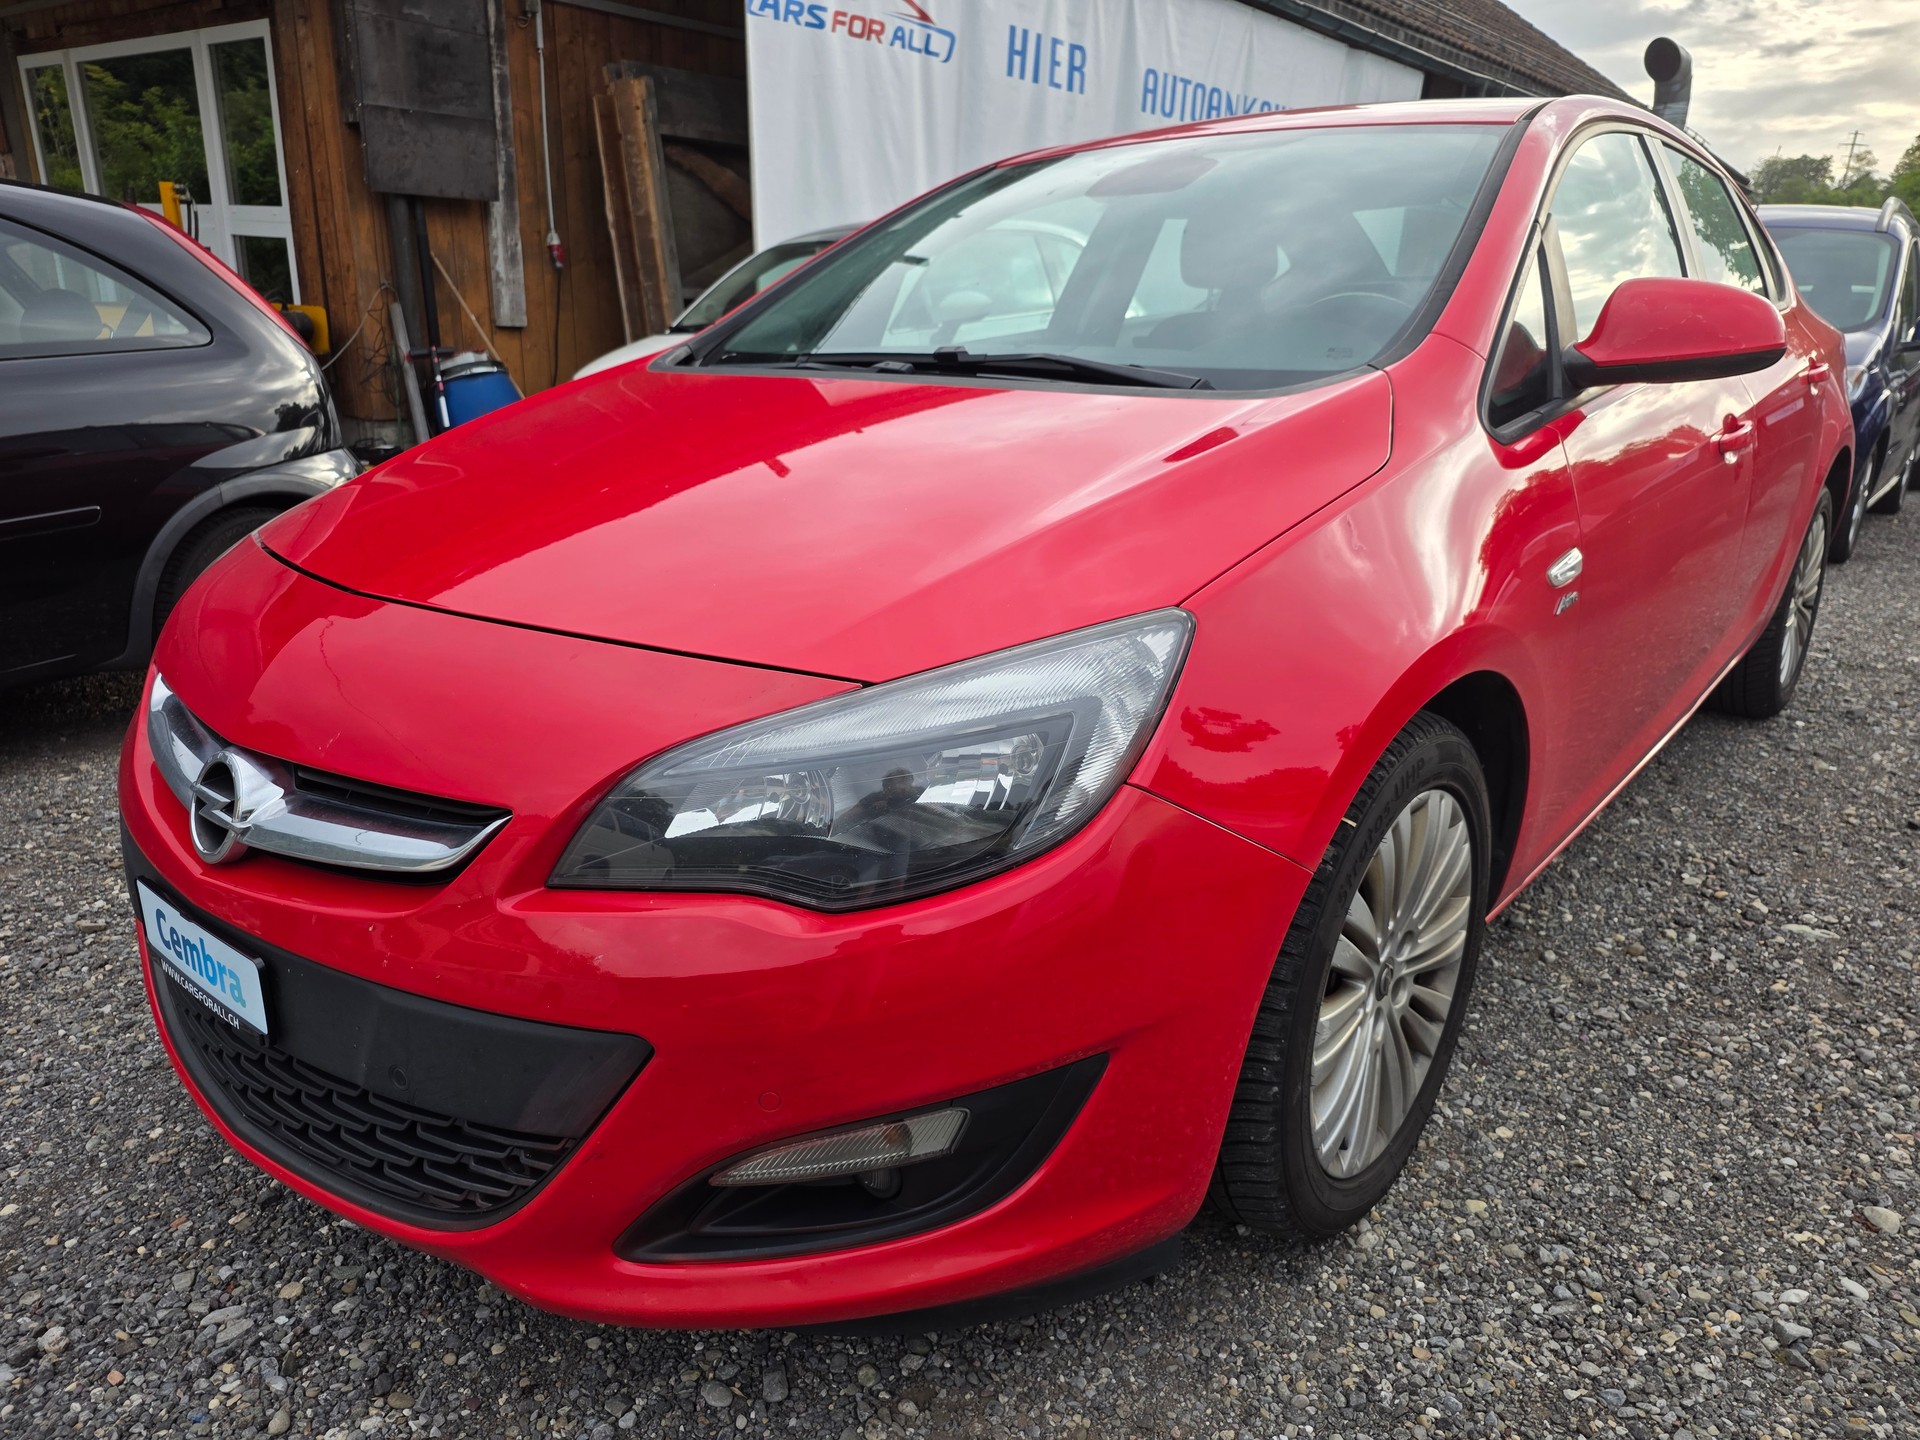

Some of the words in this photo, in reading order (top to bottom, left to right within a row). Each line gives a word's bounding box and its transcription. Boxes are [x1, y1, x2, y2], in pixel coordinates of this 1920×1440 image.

[831, 10, 886, 44] FOR
[889, 25, 940, 58] ALL
[1006, 24, 1088, 95] HIER
[1141, 67, 1294, 122] AUTOANK
[155, 908, 247, 1009] Cembra
[161, 959, 240, 1030] WWW.CARSFORALL.CH
